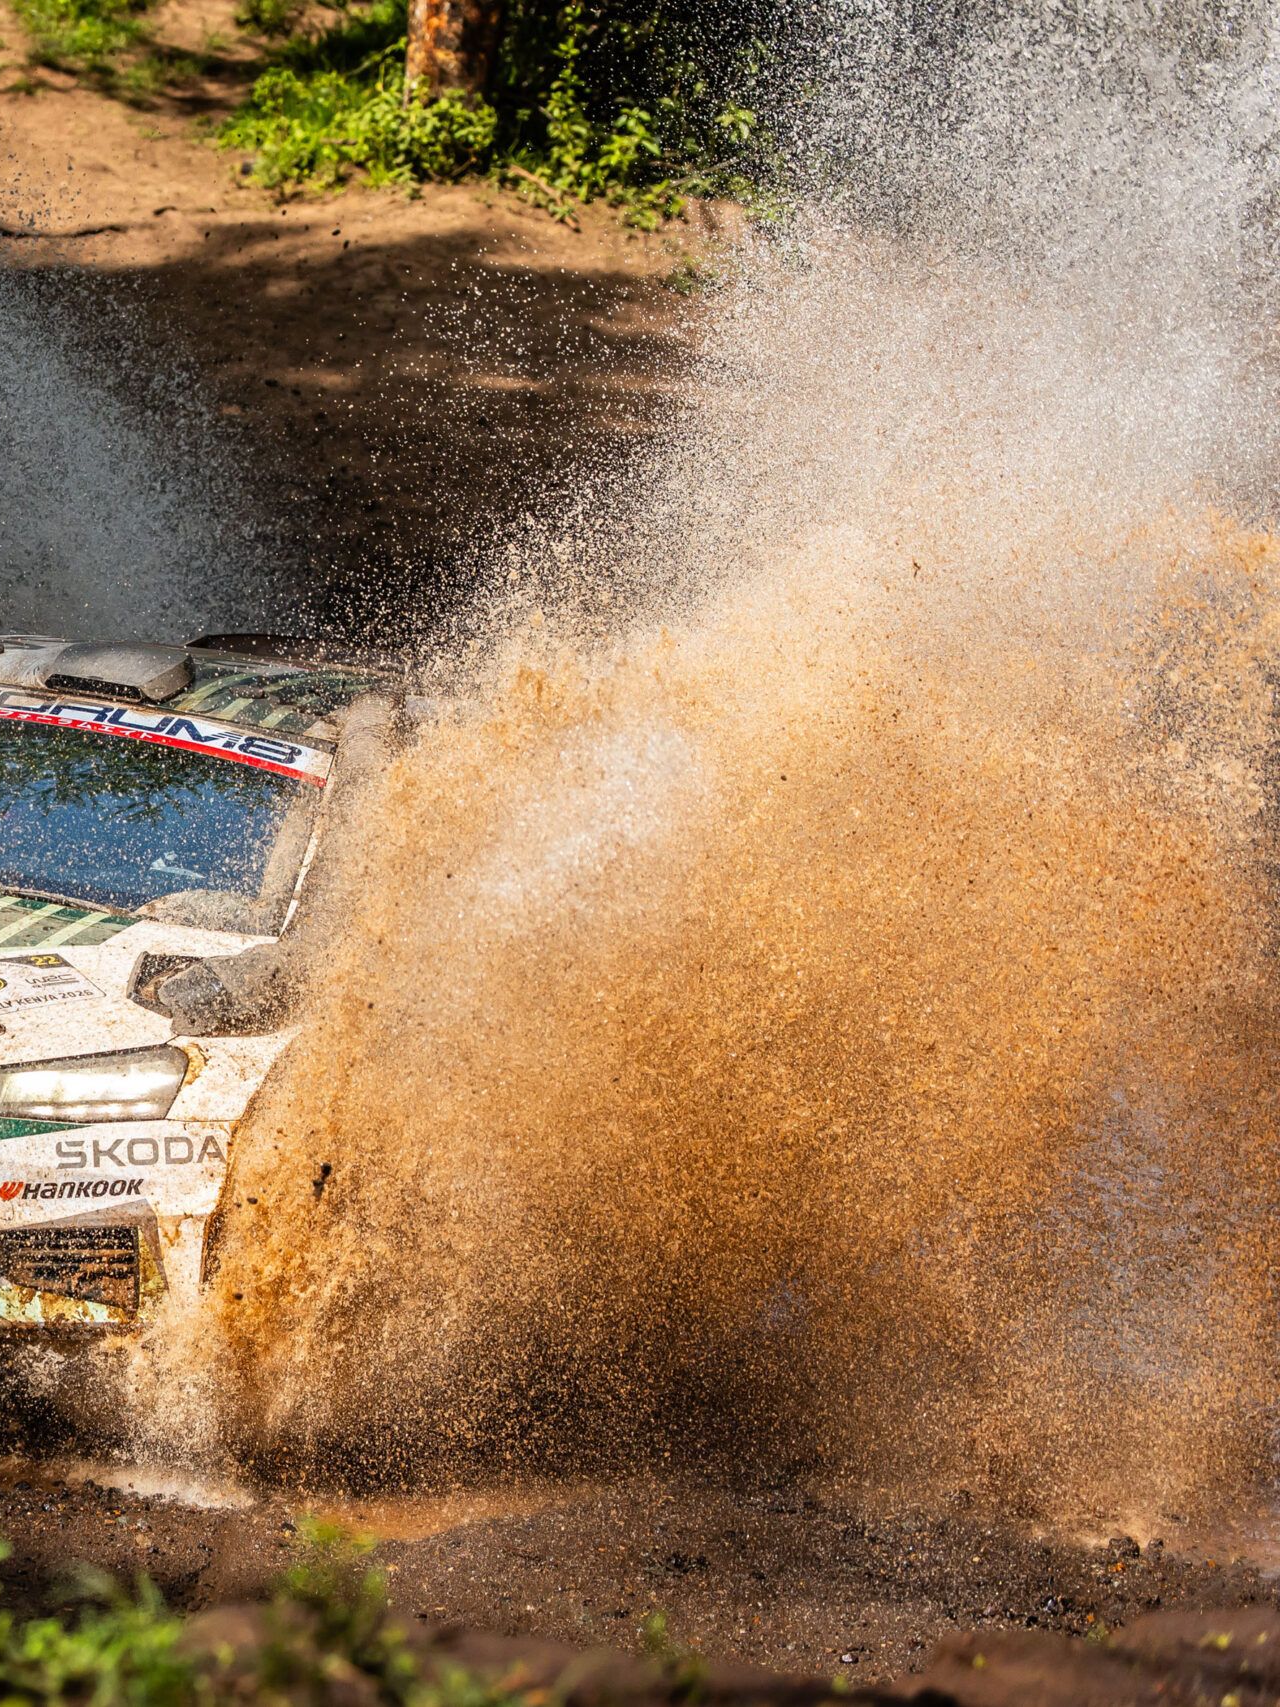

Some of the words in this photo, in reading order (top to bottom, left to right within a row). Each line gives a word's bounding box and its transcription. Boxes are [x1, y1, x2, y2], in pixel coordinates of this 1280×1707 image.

[30, 955, 61, 966] 22
[24, 973, 77, 985] WRC
[16, 993, 59, 1006] KENYA
[58, 989, 94, 999] 2026
